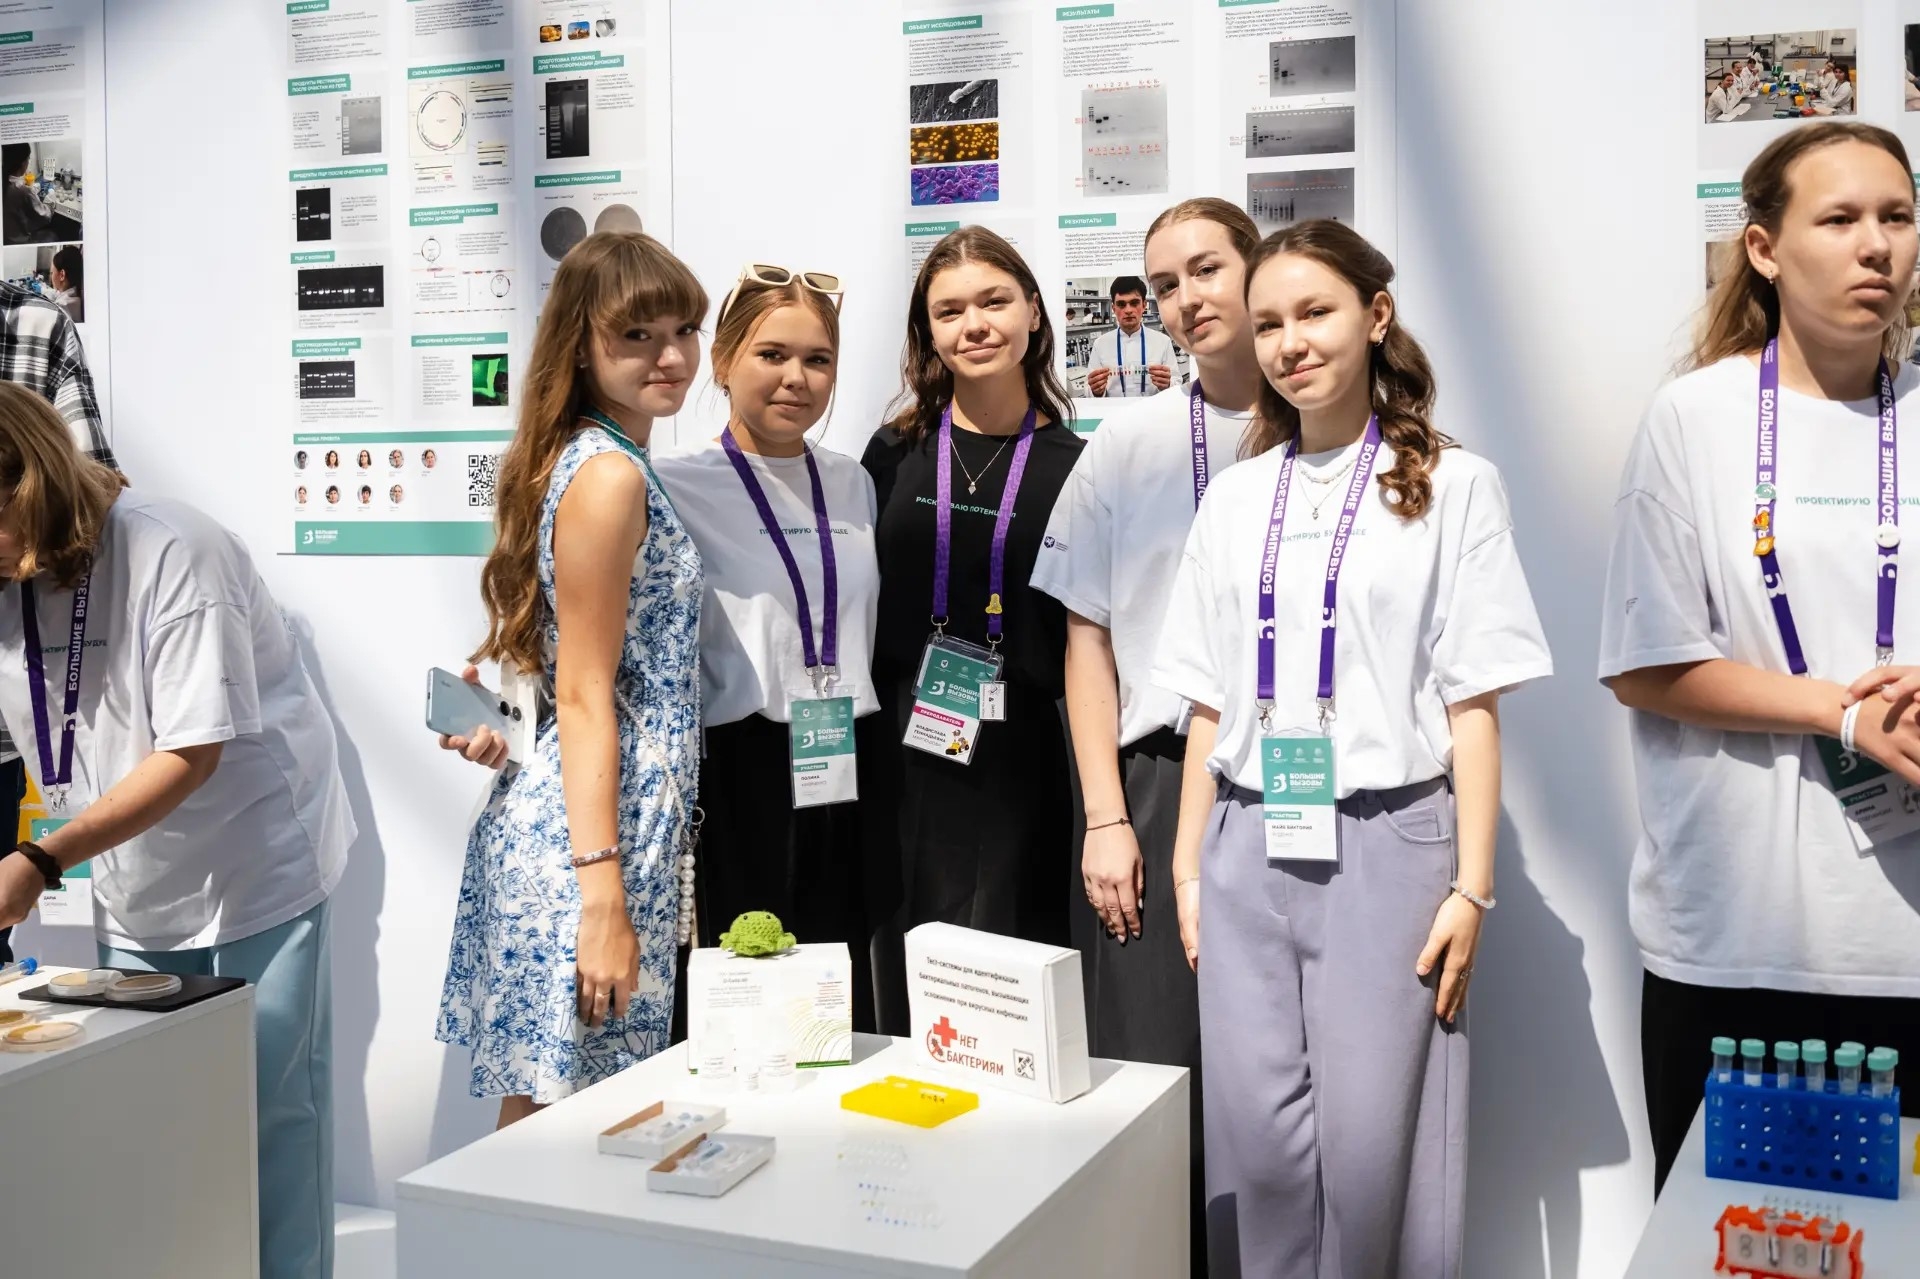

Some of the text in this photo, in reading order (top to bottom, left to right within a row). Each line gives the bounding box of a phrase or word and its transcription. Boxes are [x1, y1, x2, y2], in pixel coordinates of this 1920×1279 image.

[1062, 9, 1100, 17] РЕЗУЛЬТАТЫ
[931, 20, 977, 29] ИССЛЕДОВАНИЯ
[910, 225, 946, 233] РЕЗУЛЬТАТЫ
[1759, 388, 1774, 466] БОЛЬШИЕ
[1192, 394, 1207, 501] ОЛЬШИЕ ВЫЗОВЫ
[1881, 373, 1895, 524] БОЛЬШИЕ ВЫЗОВЫ
[916, 496, 1016, 518] РАСКВАЮ ПОТЕНЦЛ
[1795, 496, 1871, 506] ПРОЕКТИРУЮ
[1327, 442, 1376, 581] БОЛЬШИЕ ВЫЗОВЫ
[1262, 457, 1293, 595] БОЛЬШИЕ ВЫЗОВЫ
[1263, 532, 1320, 544] ЕКТИРУЮ
[68, 576, 89, 691] БОЛЬШИЕ ВЫЗО
[947, 688, 977, 702] ВЫЗОВЫ
[920, 709, 961, 726] ПРЕПОДАВАТЕЛЬ
[817, 726, 848, 735] БОЛЬШИЕ
[916, 724, 946, 737] ВЛАДИСЛАВА
[1289, 772, 1326, 780] БОЛЬШИЕ
[1289, 779, 1323, 787] ВЫЗОВЫ
[927, 956, 1019, 985] Тест-системы для идентификации
[919, 971, 1029, 1005] бактериальных патогенов, вызывающих
[957, 998, 967, 1008] при
[968, 1001, 995, 1014] вирусных
[959, 1034, 979, 1050] НЕТ
[946, 1050, 1004, 1076] БАКТЕРИЯМ
